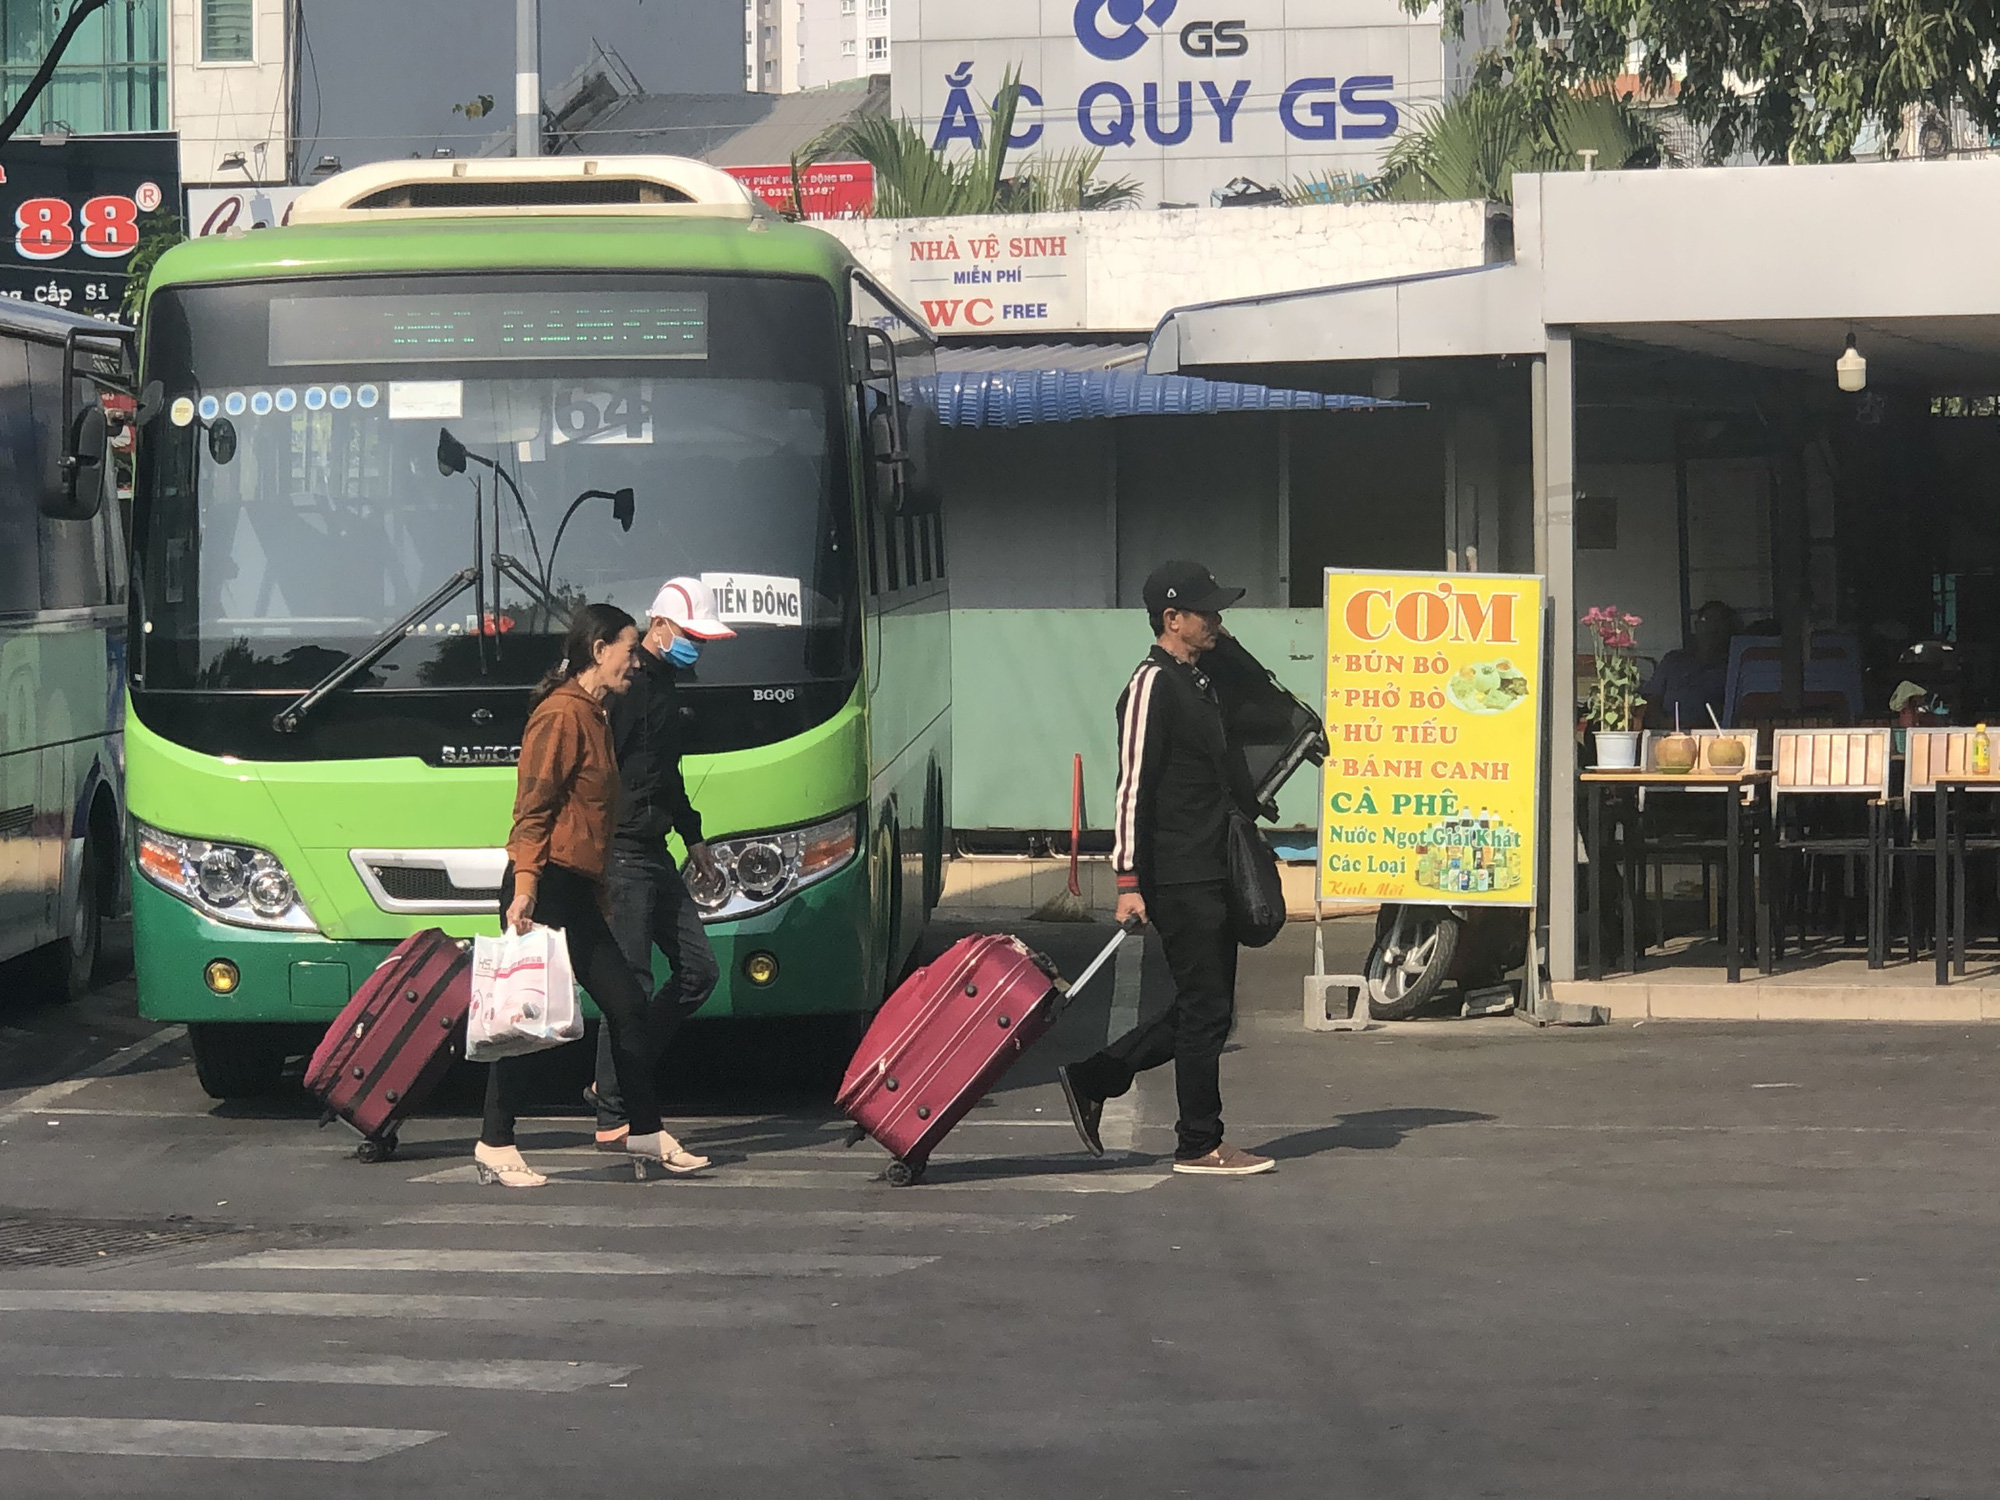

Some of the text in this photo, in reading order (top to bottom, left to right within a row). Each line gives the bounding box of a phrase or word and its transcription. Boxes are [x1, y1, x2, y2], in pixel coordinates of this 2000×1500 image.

[1179, 20, 1249, 58] GS
[932, 61, 1399, 150] ẮC QUY GS
[909, 233, 1067, 263] NHÀ VỆ SINH
[953, 265, 1022, 285] MIỄN PHÍ
[920, 298, 995, 327] WC
[1002, 303, 1048, 320] FREE
[752, 584, 799, 617] ĐÔNG
[1345, 582, 1518, 643] CƠM
[1345, 650, 1450, 675] BÚN BÒ
[753, 689, 795, 703] BGQ6
[1344, 682, 1446, 709] PHỞ BÒ
[1344, 716, 1458, 744] HỦ TIẾU
[1342, 754, 1510, 780] BÁNH CANH
[1330, 785, 1460, 816] CÀ PHÊ
[1329, 825, 1521, 849] Nước Ngọt Giải Khát
[1329, 854, 1406, 877] Các Loại
